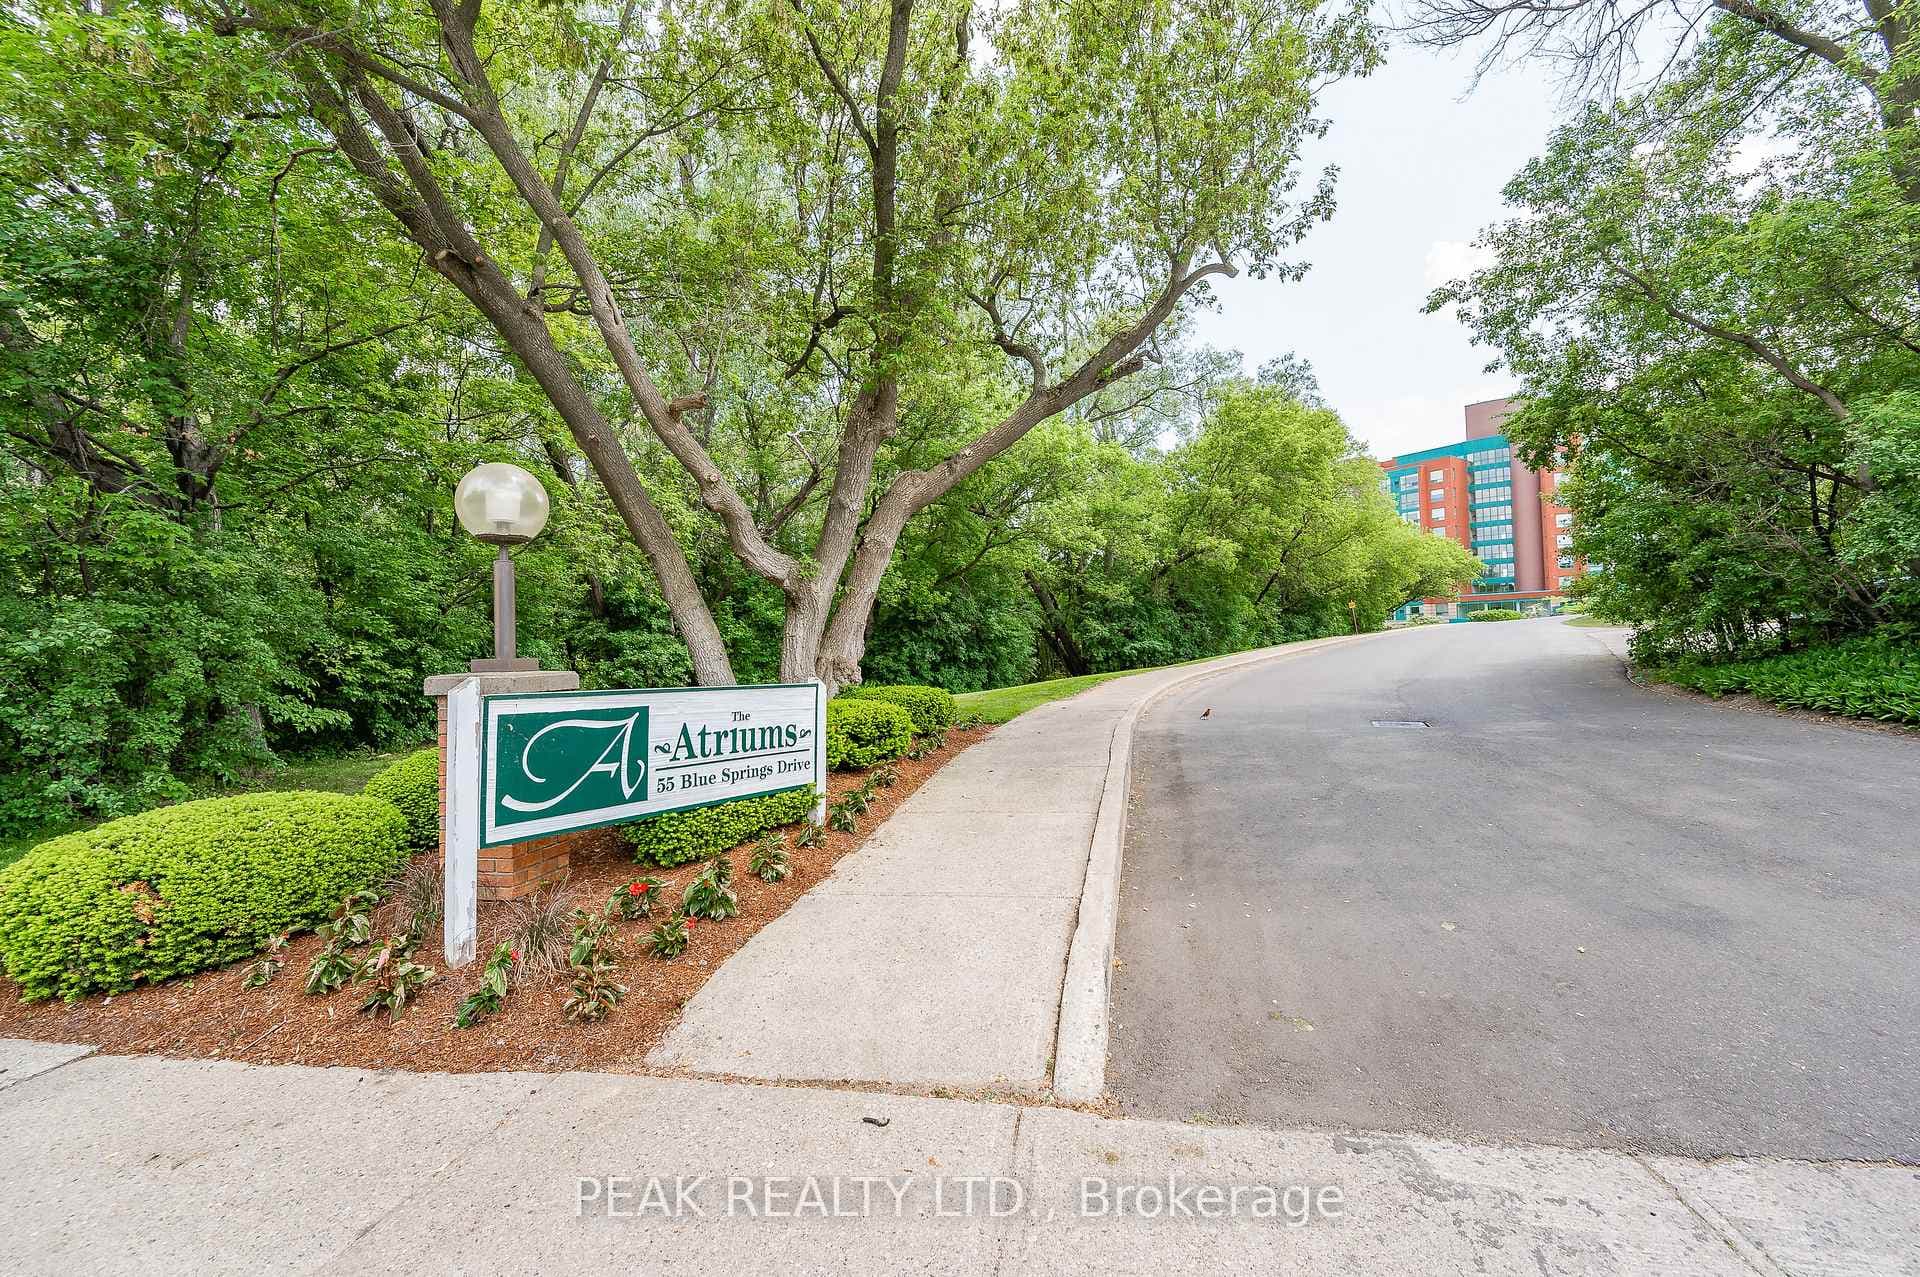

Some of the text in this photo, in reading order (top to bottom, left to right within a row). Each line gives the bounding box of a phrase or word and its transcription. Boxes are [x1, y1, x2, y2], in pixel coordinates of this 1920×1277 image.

[731, 707, 751, 722] The
[669, 722, 798, 762] Atriums
[656, 759, 811, 794] 55 Blue Springs Drive
